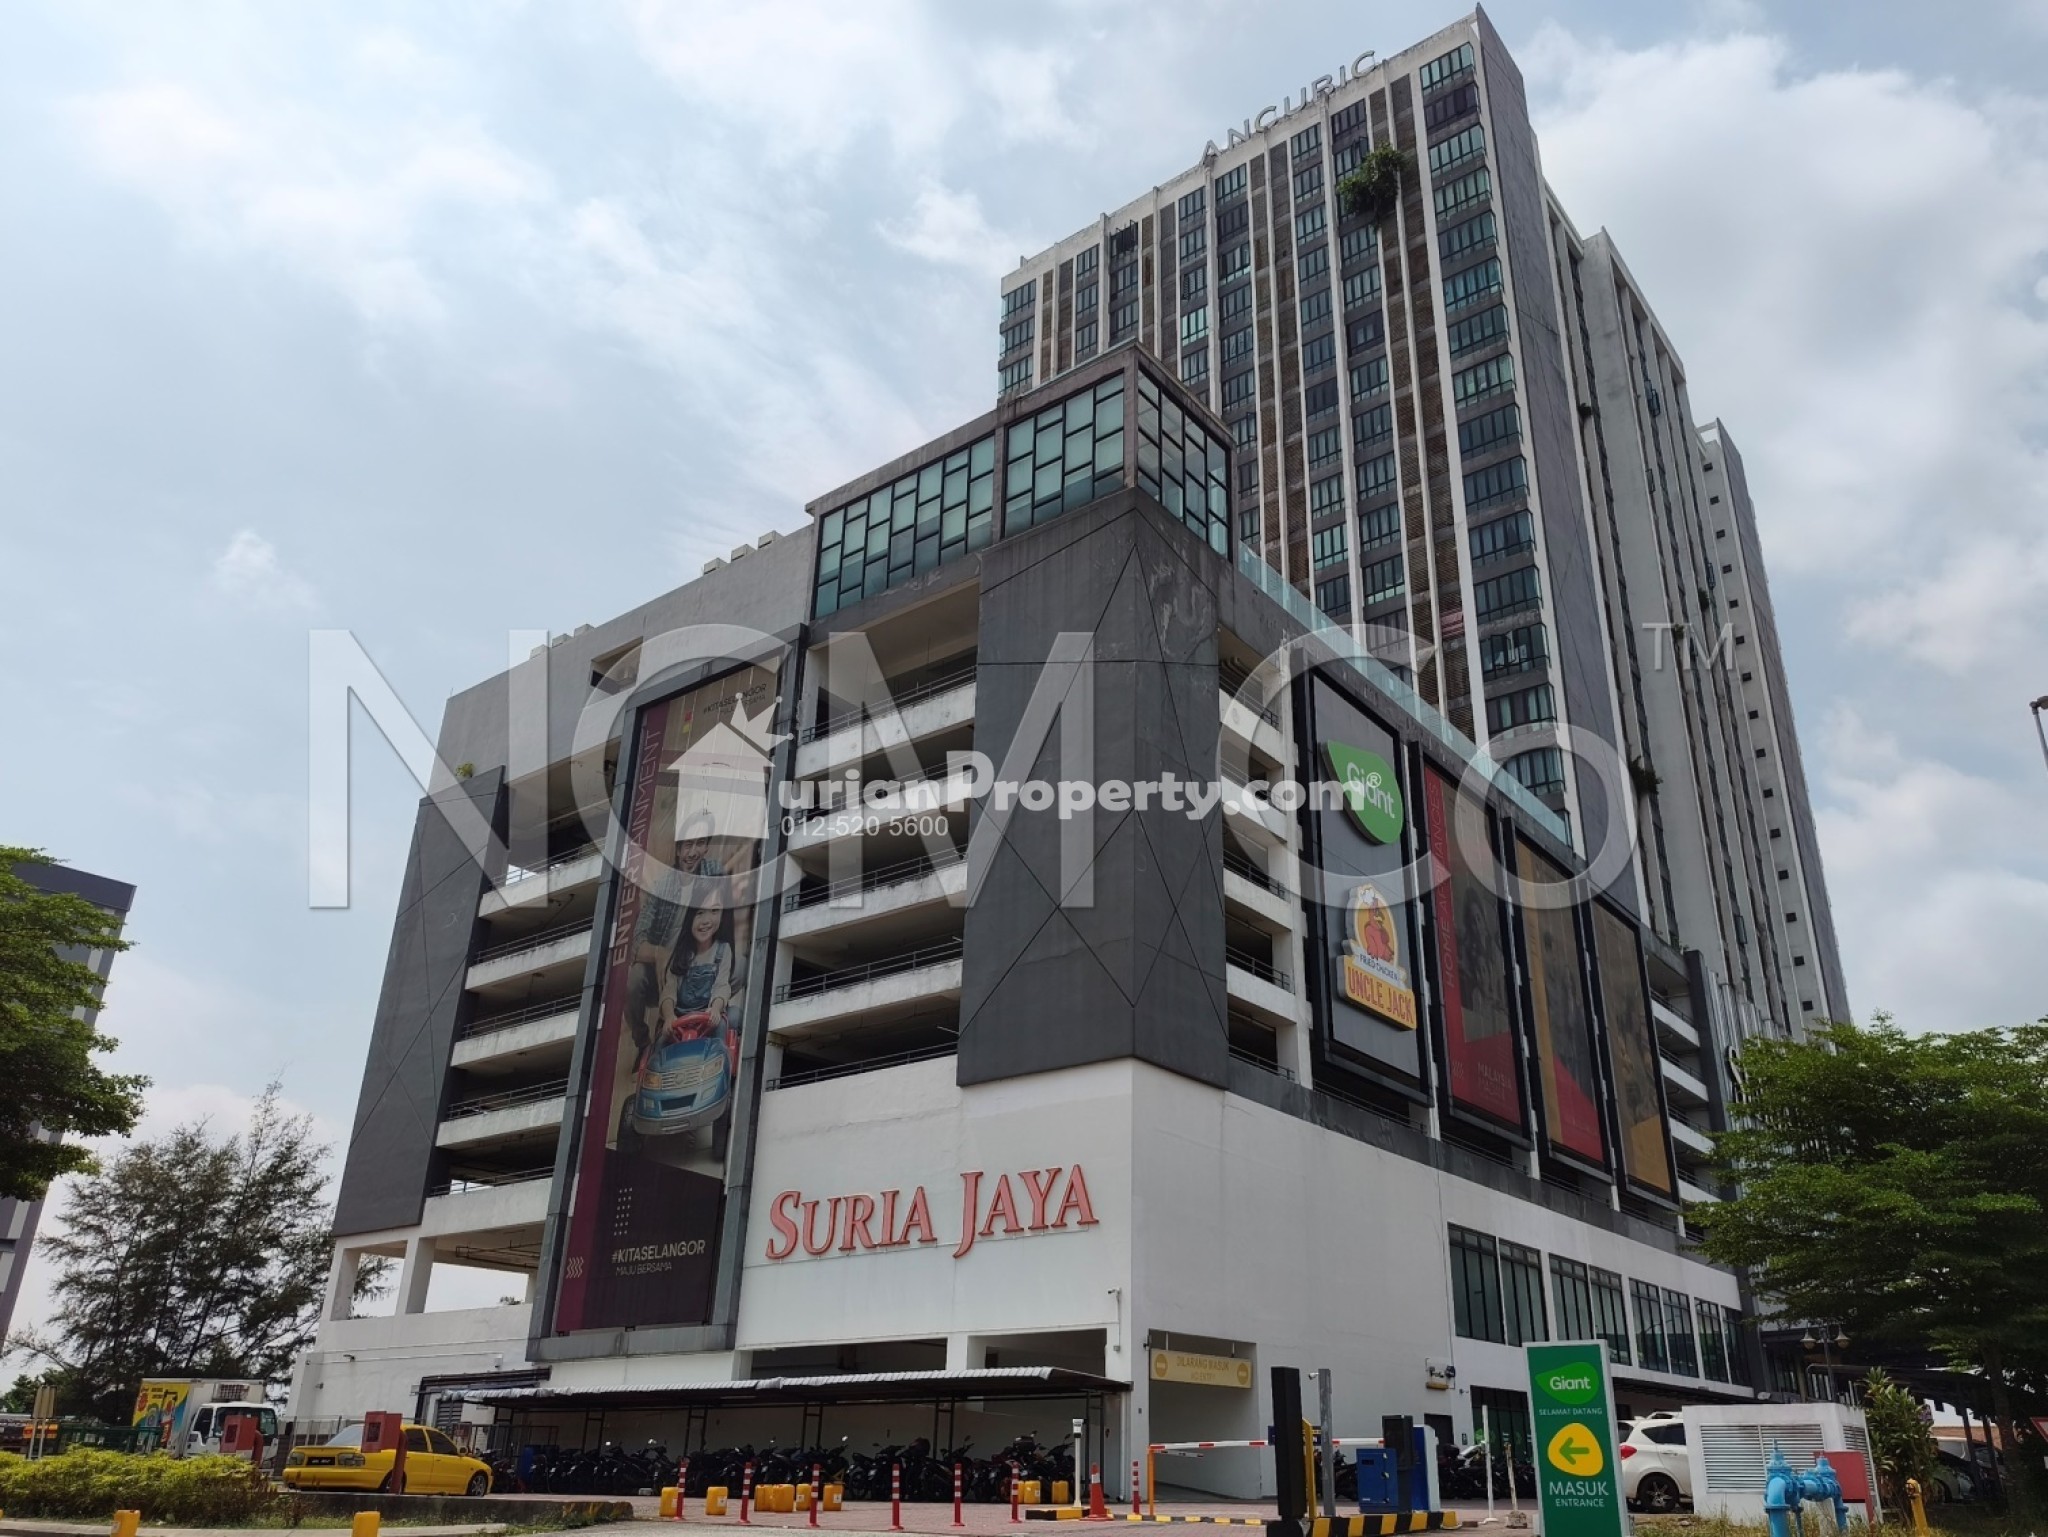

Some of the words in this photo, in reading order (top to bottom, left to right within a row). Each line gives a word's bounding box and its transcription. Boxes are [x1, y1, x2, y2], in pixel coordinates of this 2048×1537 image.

[1346, 762, 1395, 819] Giant
[613, 728, 661, 967] ENTERTAINMENT
[1440, 917, 1455, 988] HOME
[1360, 954, 1376, 969] FRIED
[1376, 962, 1398, 981] CHICKEN
[1348, 966, 1384, 1009] UNCLE
[1387, 987, 1414, 1025] JACK
[766, 1186, 938, 1260] SURIA
[952, 1164, 1099, 1259] JAYA
[612, 1239, 706, 1263] #KITASELANGOR
[637, 1261, 672, 1275] BERSAMA
[1550, 1376, 1591, 1390] Giant
[1539, 1408, 1571, 1416] SELAMAT
[1573, 1407, 1602, 1416] DATANG
[1549, 1481, 1609, 1496] MASUK
[1556, 1498, 1605, 1508] ENTRANCE
